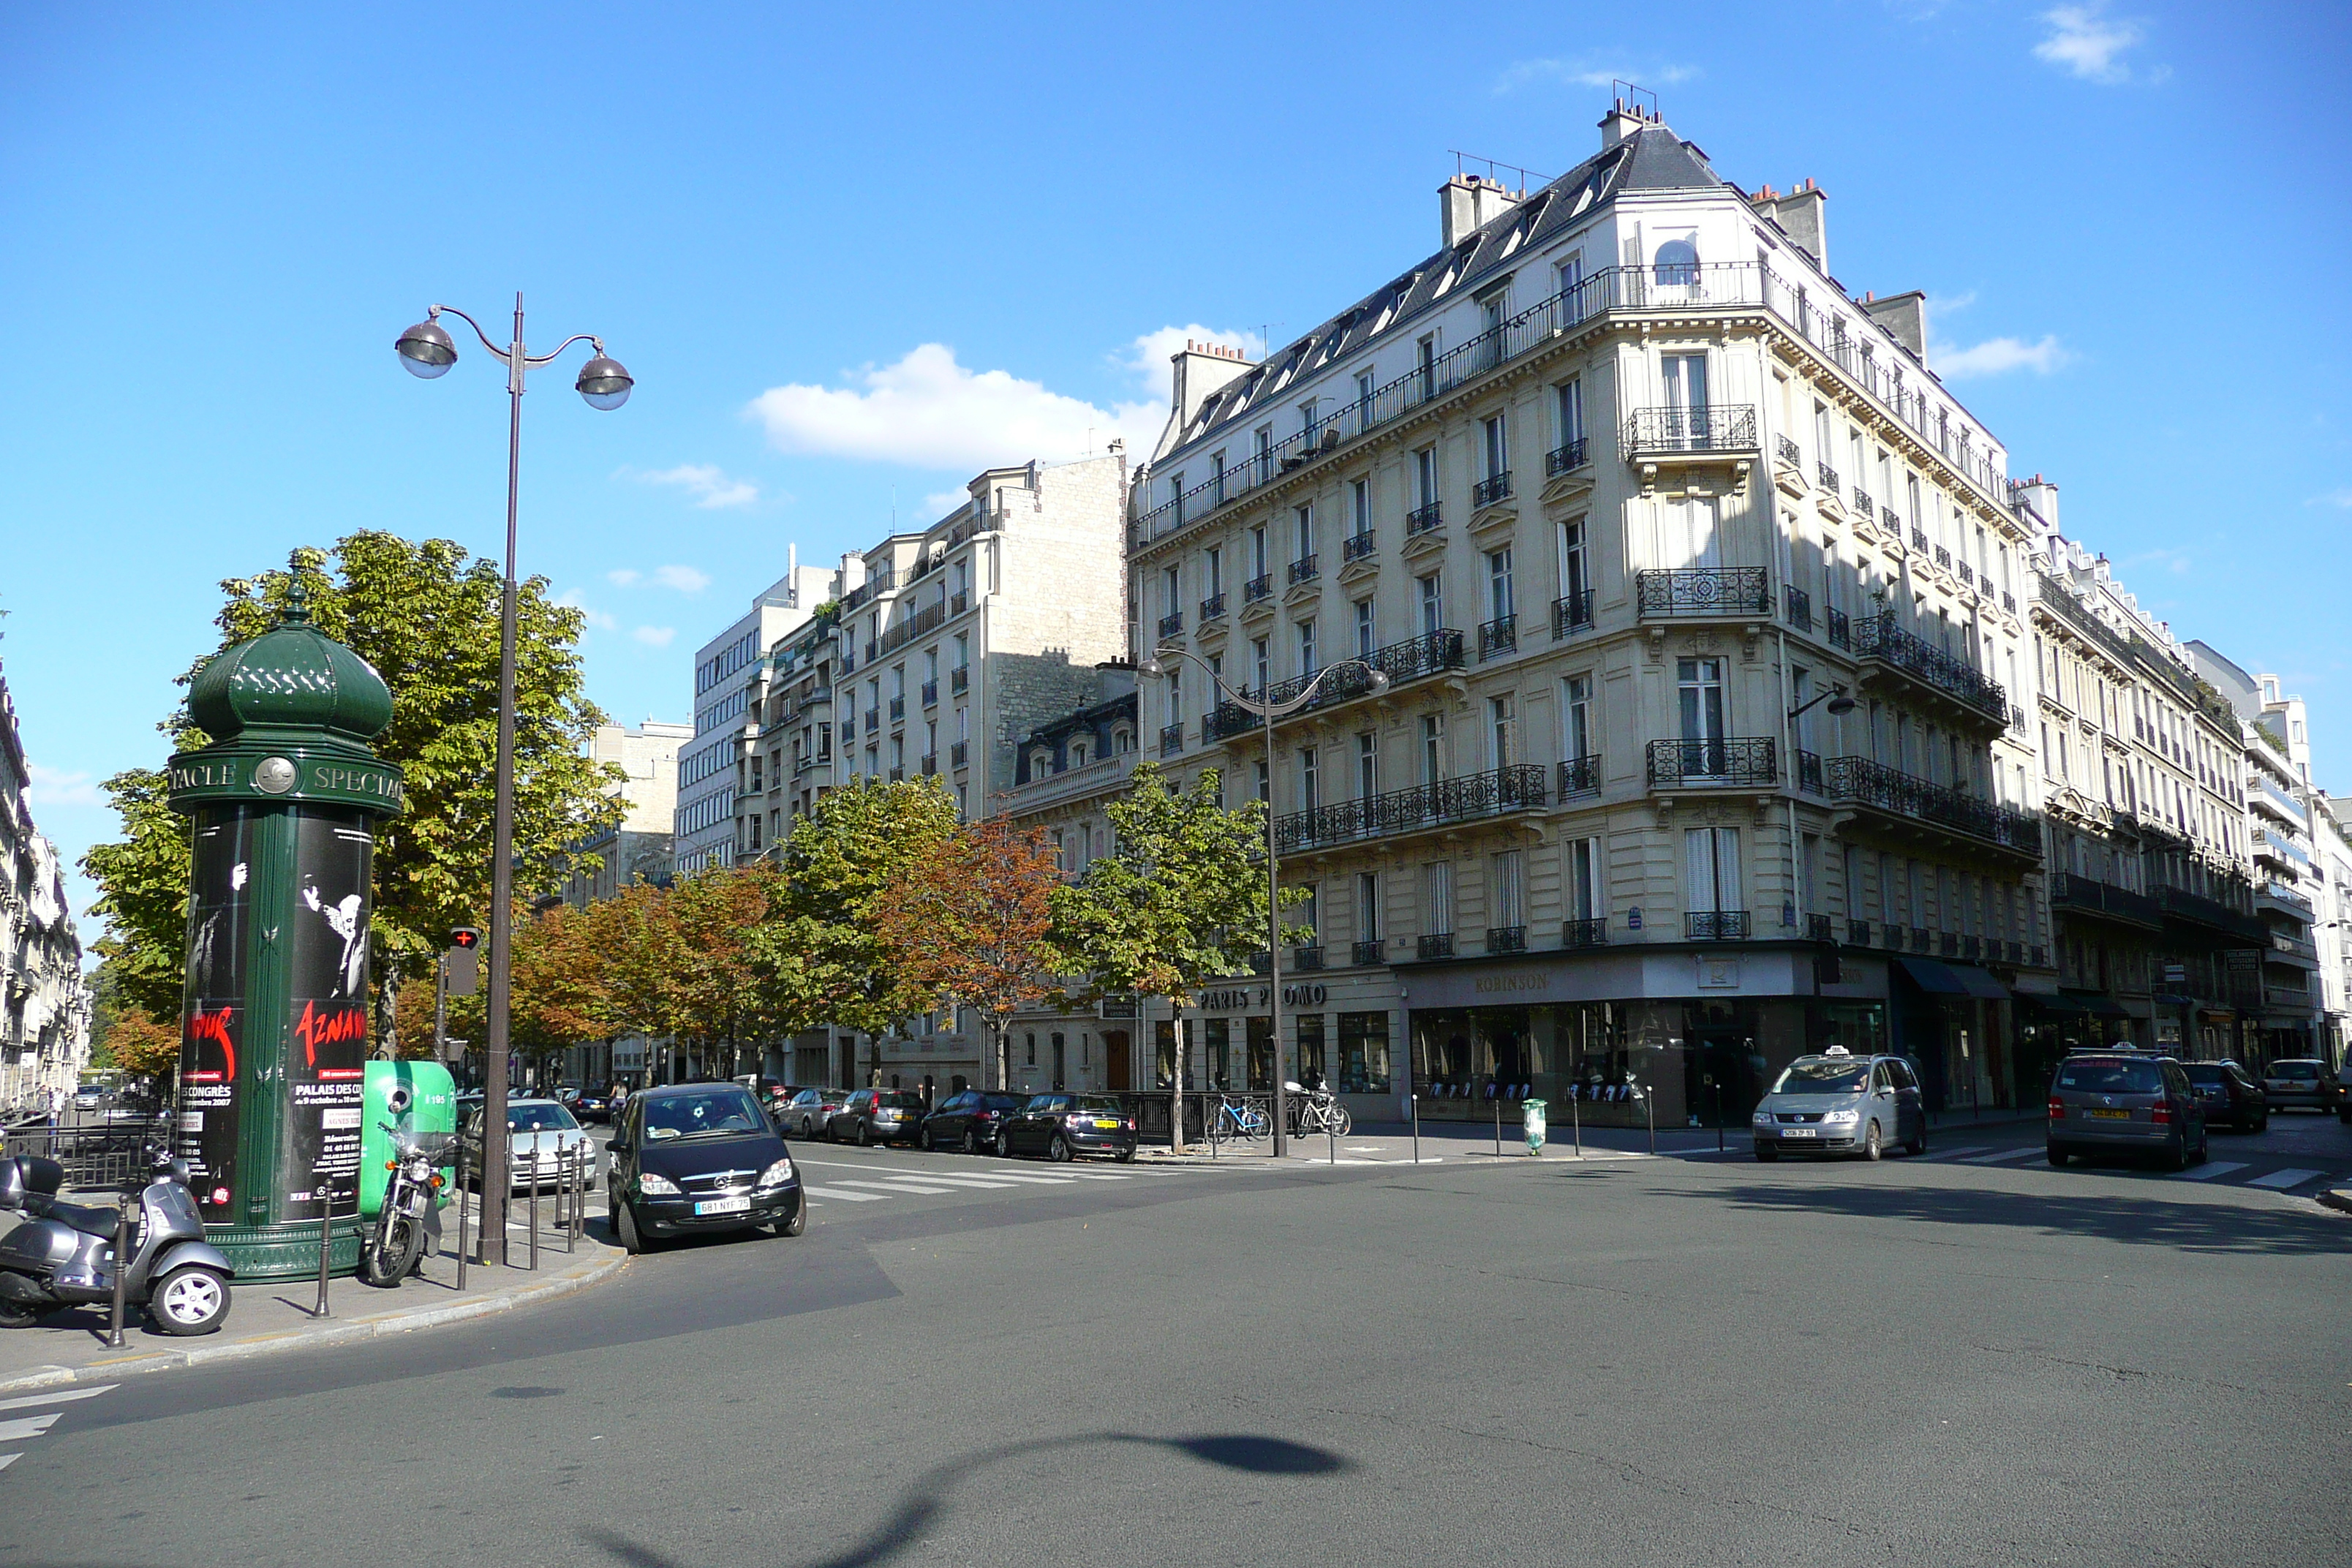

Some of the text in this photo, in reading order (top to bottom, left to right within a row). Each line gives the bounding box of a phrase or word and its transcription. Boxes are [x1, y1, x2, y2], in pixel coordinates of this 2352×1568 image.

[1476, 973, 1547, 993] ROBINSON
[1199, 984, 1324, 1010] PARIS POMO
[188, 1085, 231, 1097] CONGRÈS
[295, 1085, 334, 1096] PALAIS
[336, 1084, 352, 1095] DES
[309, 1096, 337, 1104] octobre
[431, 1095, 445, 1104] 195
[702, 1199, 749, 1212] 681 NYF 75
